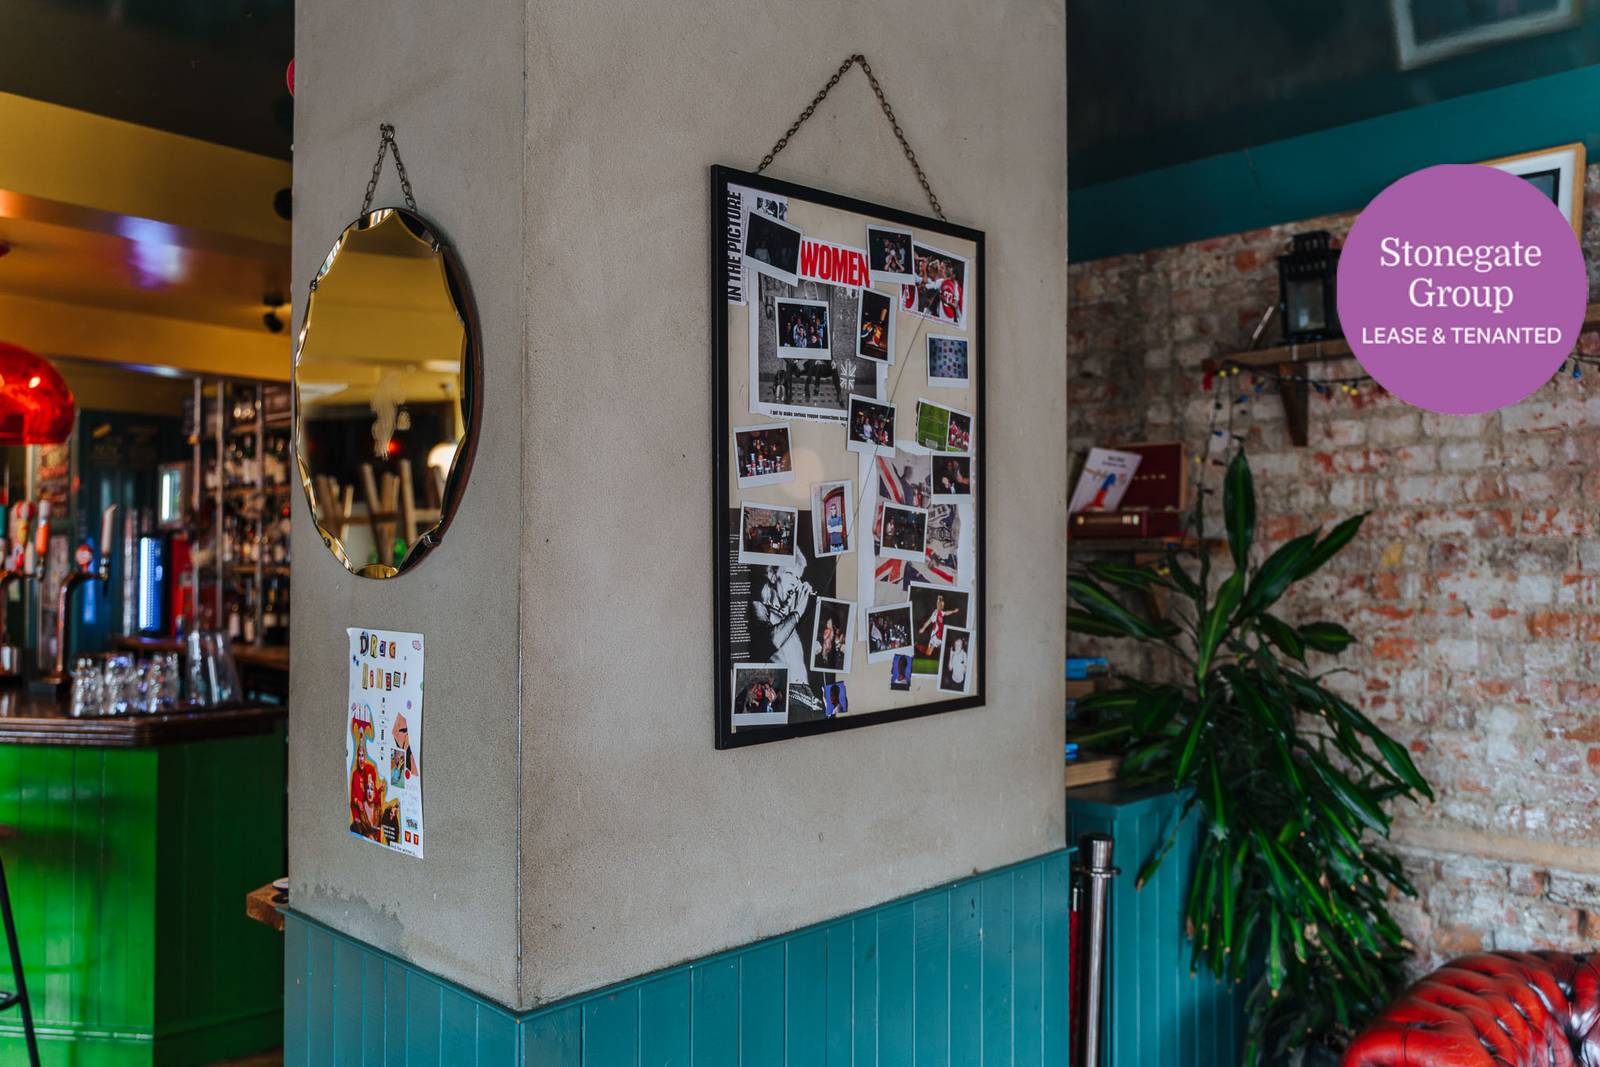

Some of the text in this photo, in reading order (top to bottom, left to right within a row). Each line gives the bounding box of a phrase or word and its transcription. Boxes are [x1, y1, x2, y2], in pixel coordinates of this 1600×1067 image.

[728, 190, 742, 303] IN THE PICTURE
[800, 240, 870, 289] WOMEN
